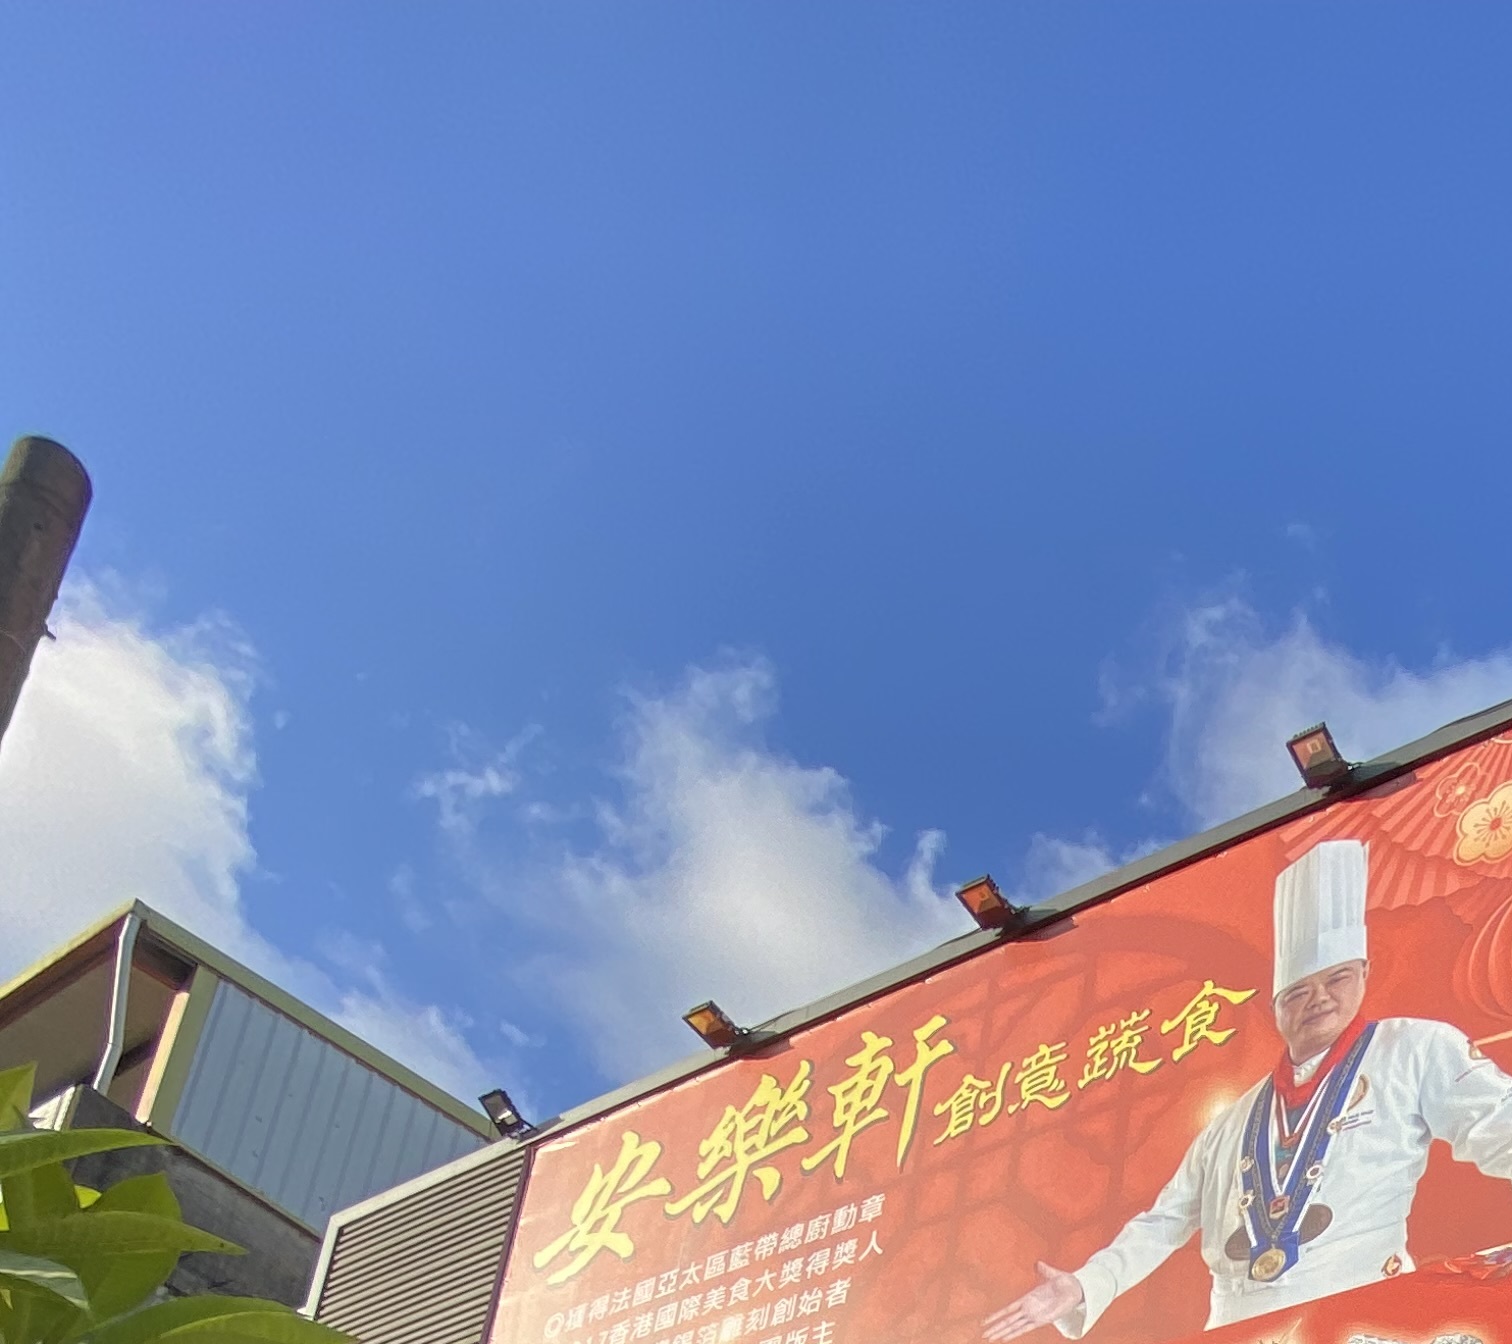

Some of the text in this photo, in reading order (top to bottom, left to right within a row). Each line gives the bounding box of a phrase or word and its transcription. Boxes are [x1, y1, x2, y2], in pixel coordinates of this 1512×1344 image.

[532, 979, 1259, 1285] 安樂軒 創意蔬食
